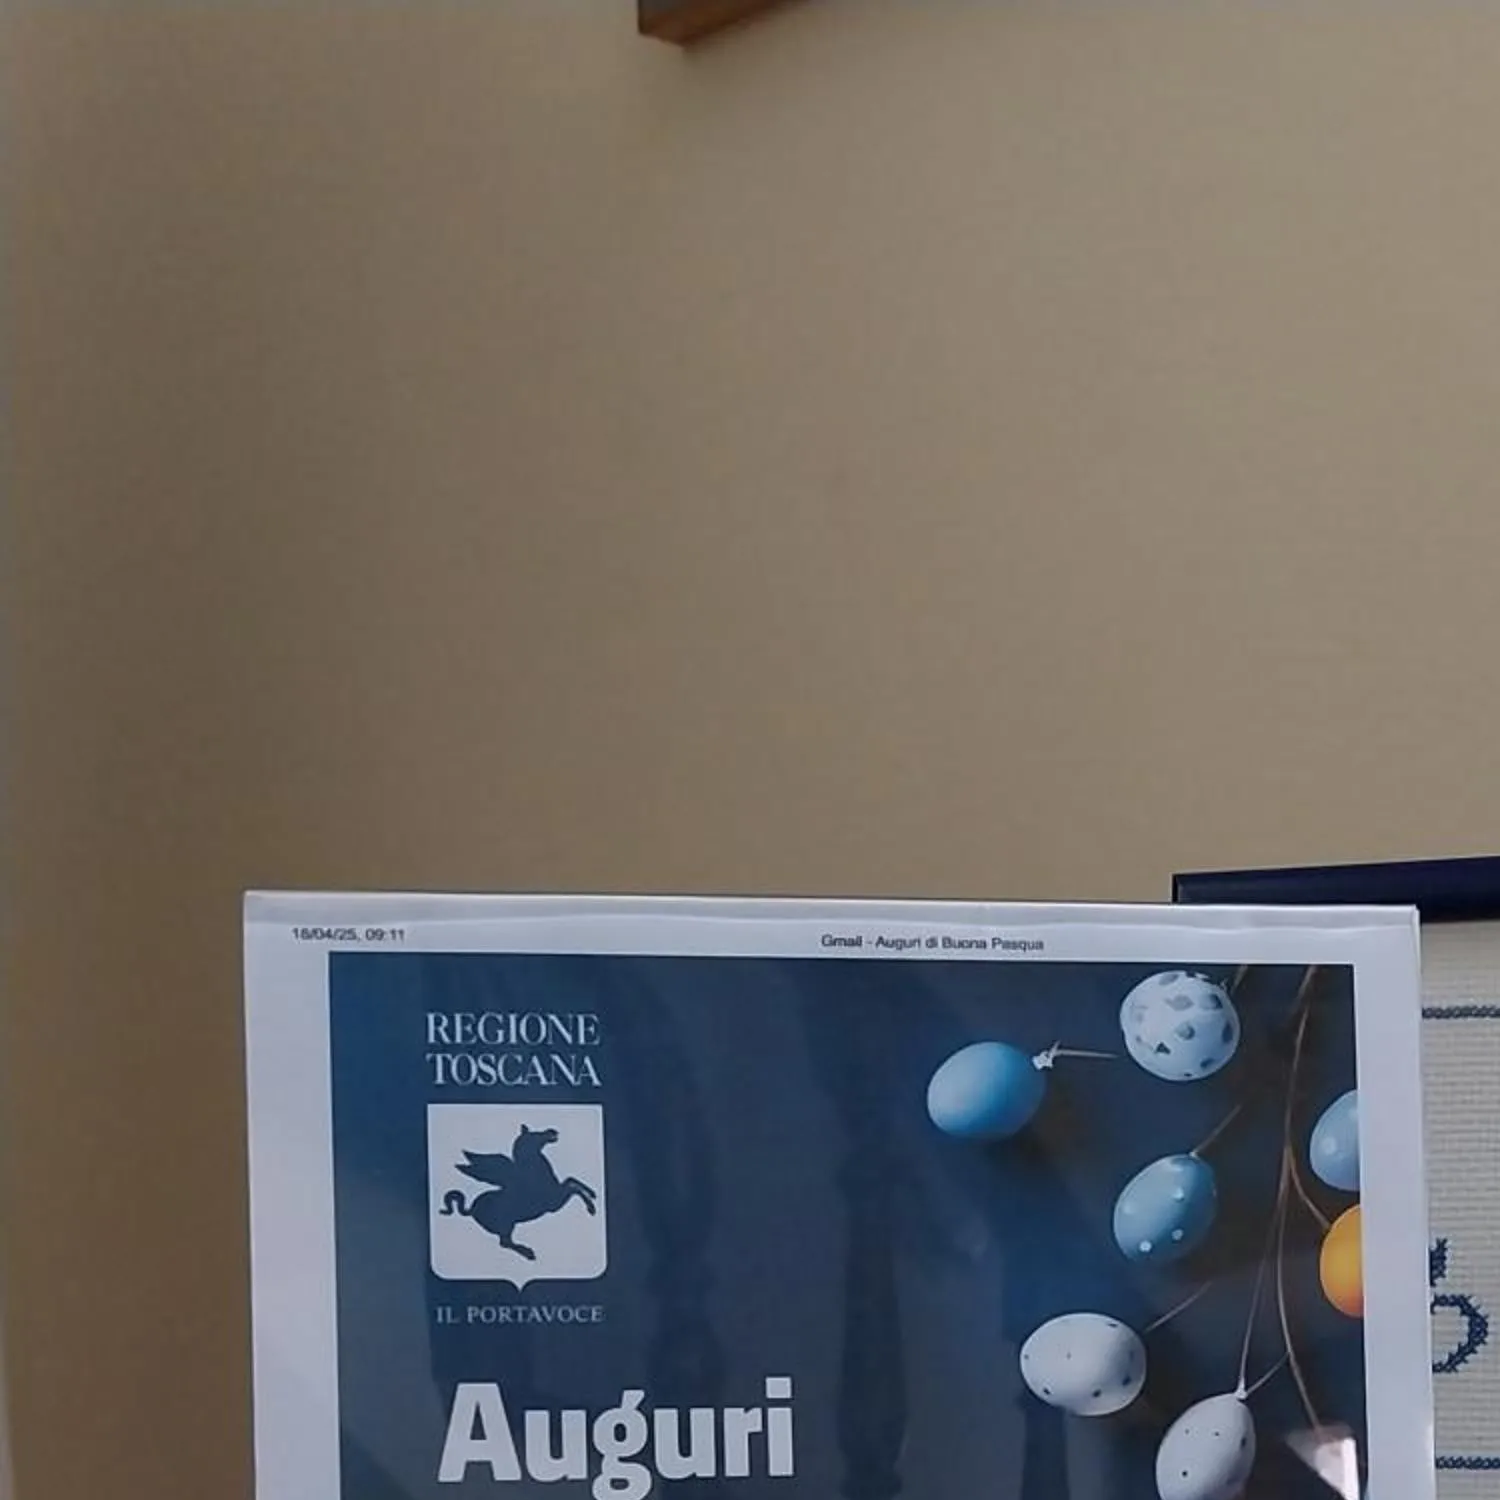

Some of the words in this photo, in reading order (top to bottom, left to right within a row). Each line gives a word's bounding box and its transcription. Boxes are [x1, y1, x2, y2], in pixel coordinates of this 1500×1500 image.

[292, 926, 361, 942] 18/04/25,
[365, 928, 406, 942] 09:11
[820, 934, 863, 949] Gmail
[875, 935, 922, 951] Auguri
[925, 935, 939, 949] di
[942, 936, 988, 950] Buona
[991, 936, 1044, 952] Pasqua
[425, 1011, 602, 1046] REGIONE
[426, 1052, 603, 1087] TOSCANA
[436, 1306, 460, 1325] IL
[467, 1306, 604, 1325] PORTAVOCE
